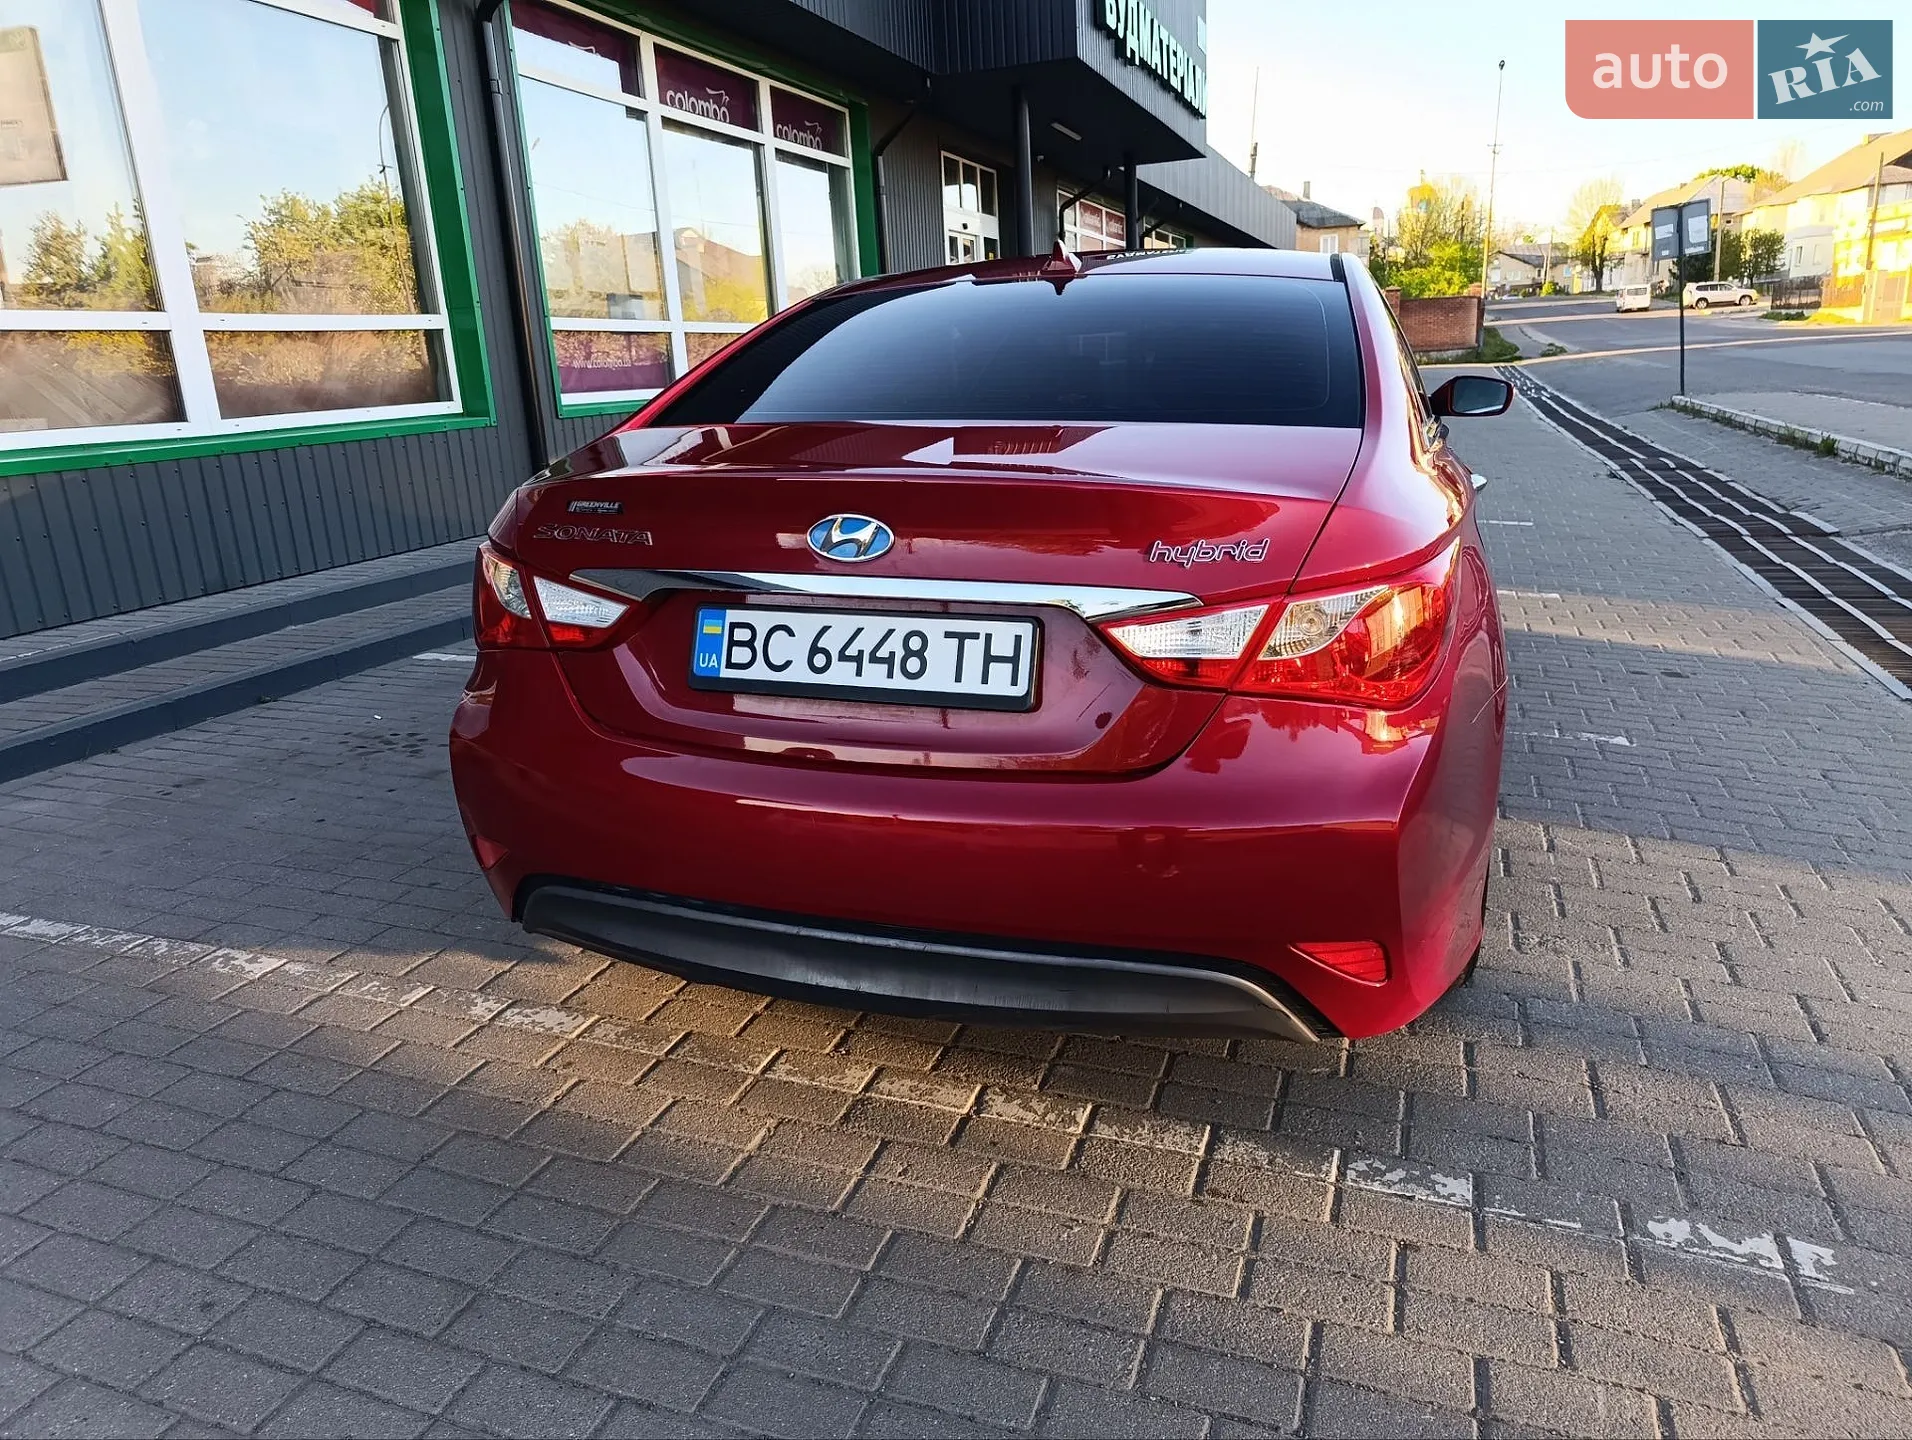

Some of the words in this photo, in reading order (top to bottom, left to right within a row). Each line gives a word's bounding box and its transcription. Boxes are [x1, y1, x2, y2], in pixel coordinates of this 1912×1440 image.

[533, 523, 653, 546] SONATA
[1149, 538, 1270, 569] hybrid
[699, 653, 718, 669] UA
[806, 624, 929, 680] 6448
[943, 631, 1023, 687] TH
